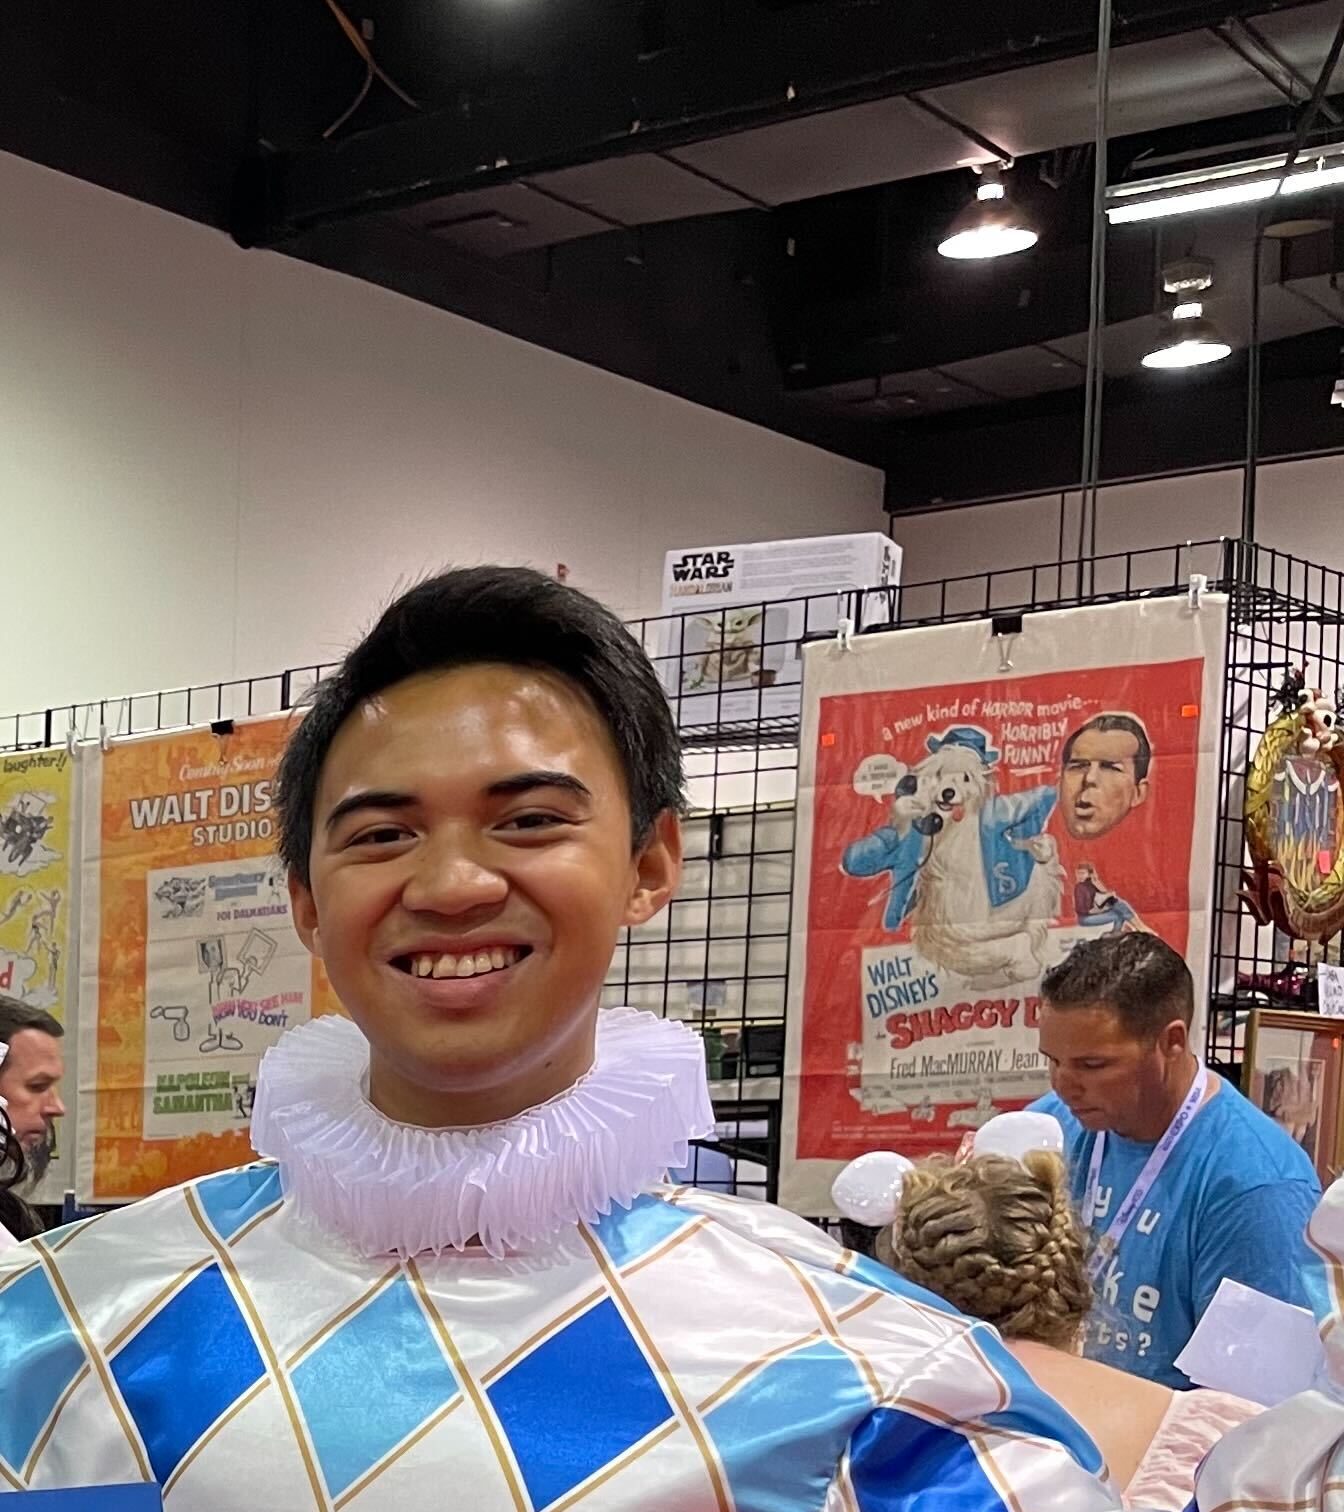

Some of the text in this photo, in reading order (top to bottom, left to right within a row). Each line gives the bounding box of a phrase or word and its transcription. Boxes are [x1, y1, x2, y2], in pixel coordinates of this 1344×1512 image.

[673, 551, 734, 569] STAR
[673, 564, 734, 581] WARS
[882, 726, 893, 741] a
[894, 713, 924, 734] new
[926, 698, 960, 722] kind
[962, 698, 981, 717] of
[982, 701, 1034, 718] HORROR
[1001, 717, 1069, 743] HORRIBLY
[231, 753, 265, 774] Soon
[1004, 741, 1060, 766] FUNNY!
[130, 780, 274, 829] WALT DIS
[867, 955, 912, 987] WALT
[866, 971, 939, 1018] DISNEY'S
[886, 998, 1019, 1049] SHAGGY
[890, 1055, 916, 1080] Fred
[921, 1048, 1002, 1077] MacMURRAY
[1011, 1049, 1039, 1072] Jean
